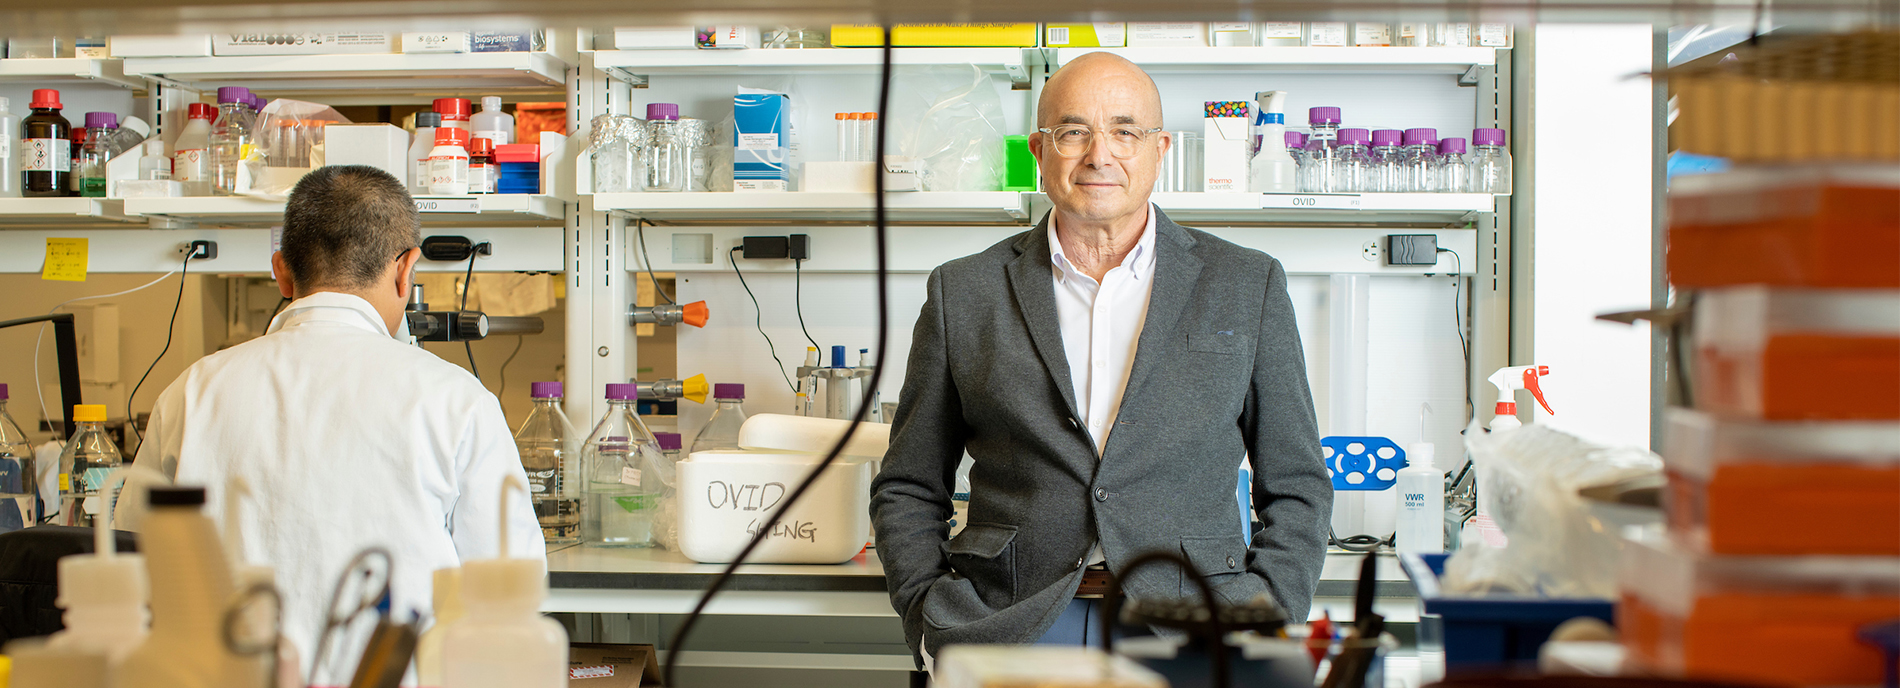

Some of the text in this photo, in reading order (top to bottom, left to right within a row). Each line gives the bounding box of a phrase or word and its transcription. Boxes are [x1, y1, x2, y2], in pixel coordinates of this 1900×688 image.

[475, 35, 519, 45] biosystems
[1292, 197, 1316, 206] OVID
[707, 480, 786, 512] OVID
[1404, 493, 1425, 501] VWR
